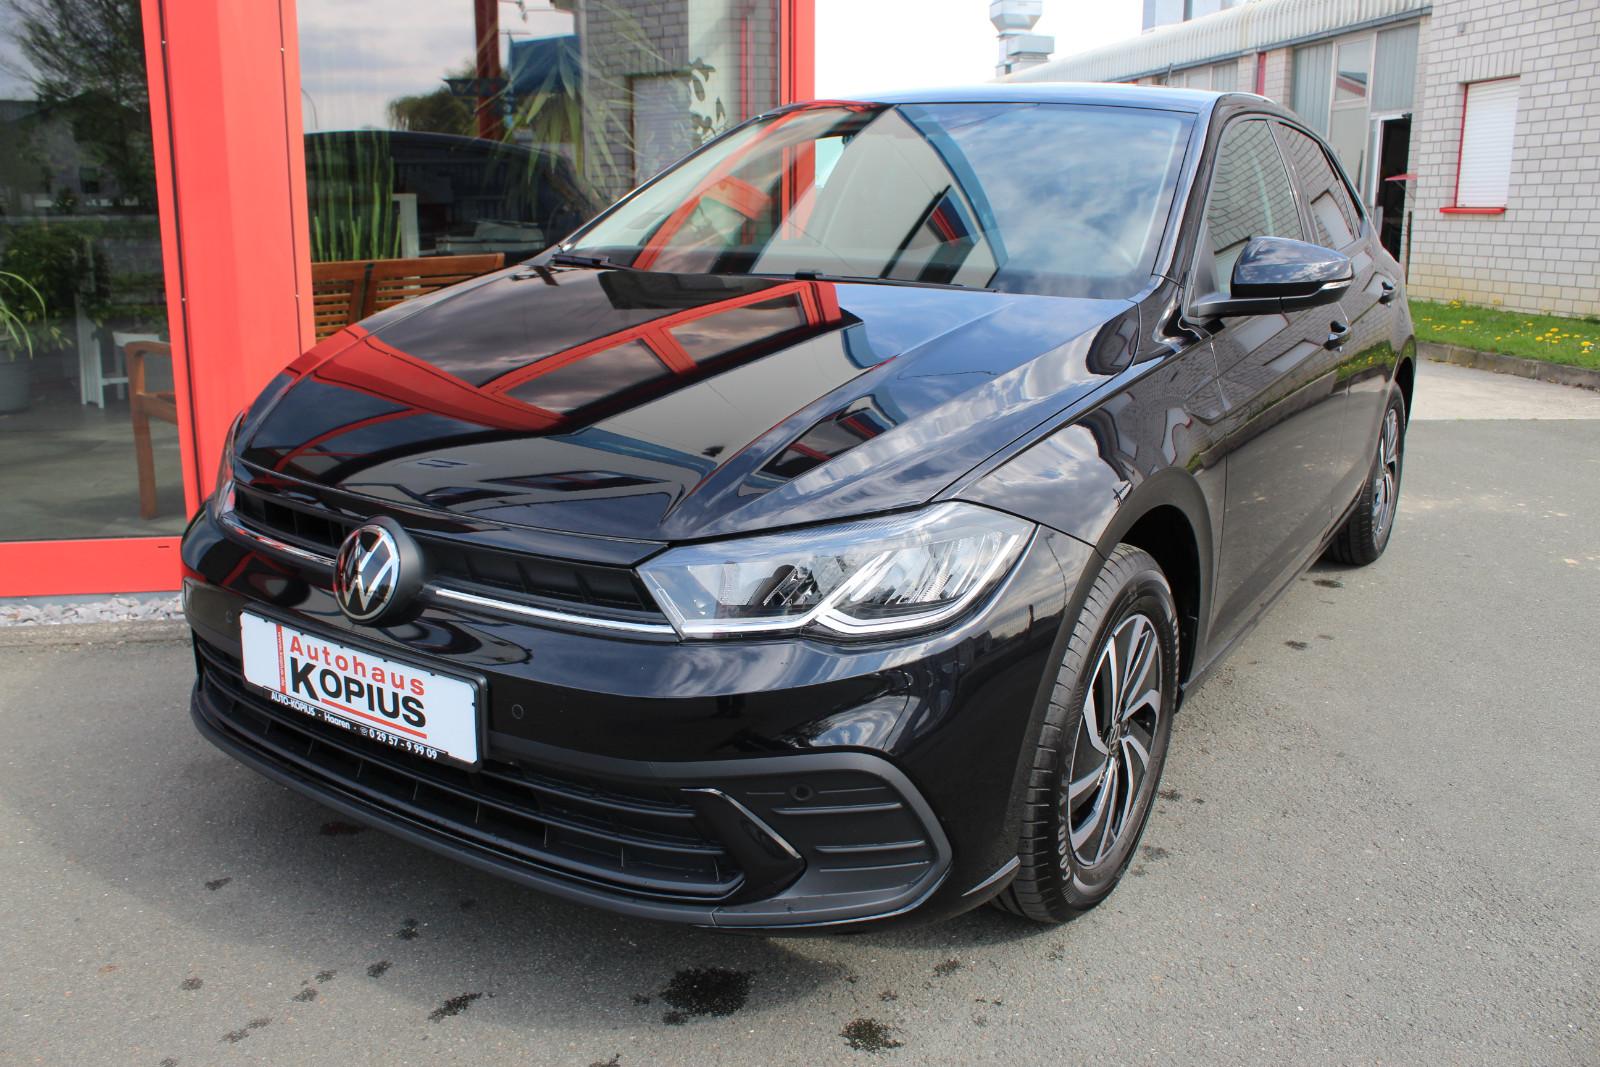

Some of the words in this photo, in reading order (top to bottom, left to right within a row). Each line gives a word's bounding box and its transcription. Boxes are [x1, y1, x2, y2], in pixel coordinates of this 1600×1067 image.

[290, 635, 425, 696] Autohaus
[290, 656, 427, 728] KOPIUS
[271, 693, 316, 717] AUTO-KOPIUS
[324, 711, 351, 730] Haaren
[376, 730, 386, 742] 29
[388, 733, 399, 746] 57
[413, 743, 424, 756] 99
[426, 747, 438, 760] 09
